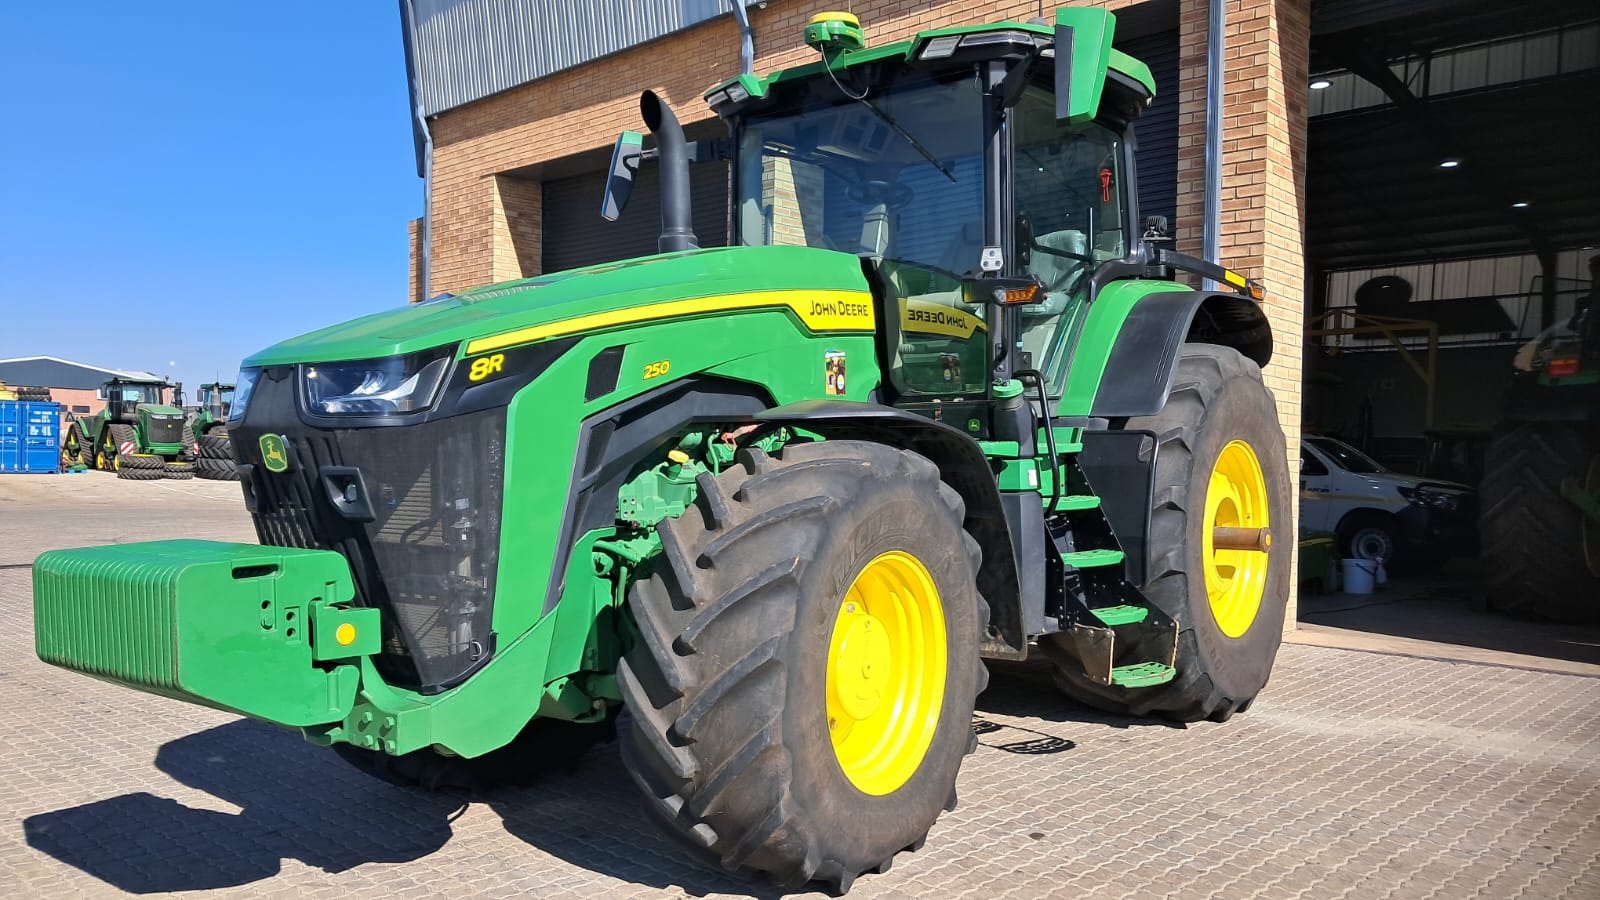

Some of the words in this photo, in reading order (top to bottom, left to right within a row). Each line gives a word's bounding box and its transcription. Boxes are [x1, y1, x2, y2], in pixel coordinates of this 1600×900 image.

[810, 299, 836, 316] JOHN
[838, 300, 868, 317] DEERE
[469, 353, 505, 381] 8R
[642, 360, 670, 380] 250
